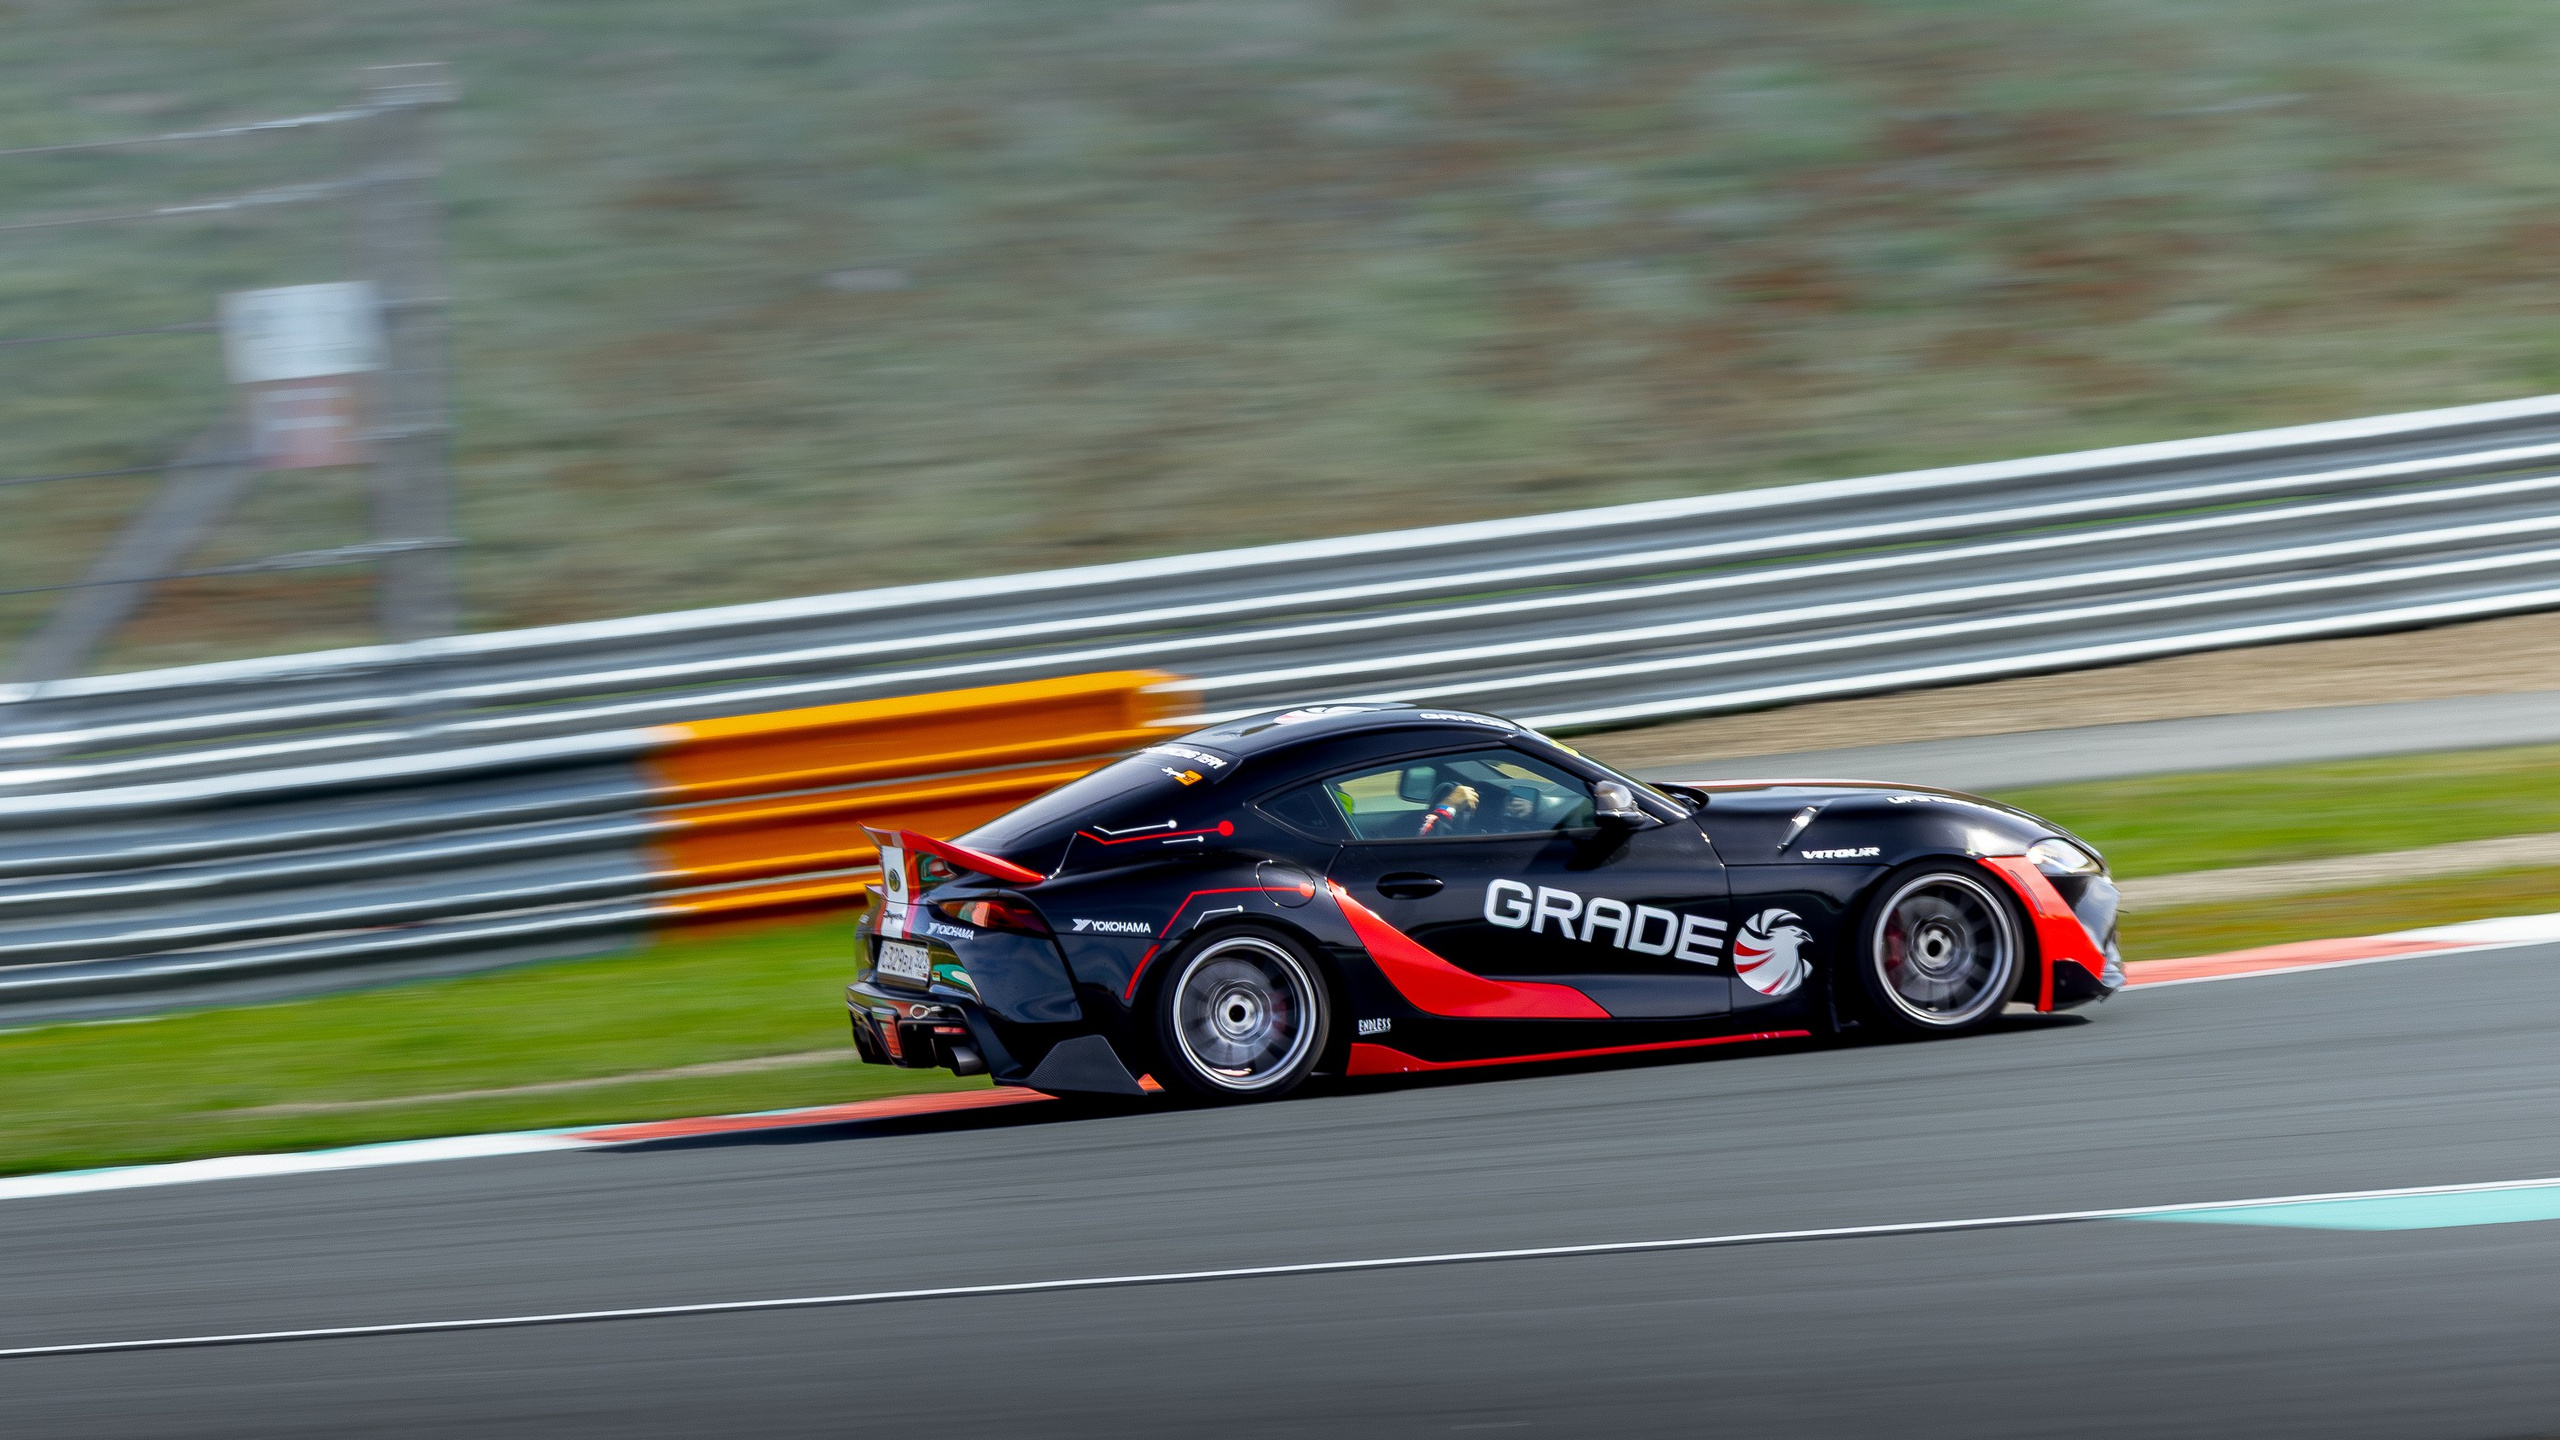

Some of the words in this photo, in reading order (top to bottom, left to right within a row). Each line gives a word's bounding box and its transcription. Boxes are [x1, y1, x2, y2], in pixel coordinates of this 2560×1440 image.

[1801, 847, 1880, 859] VITOUR
[1091, 921, 1151, 933] YOKOHAMA
[1483, 878, 1728, 966] GRADE
[937, 923, 975, 940] YOKOHAMA
[1358, 1017, 1392, 1032] ENDLESS
